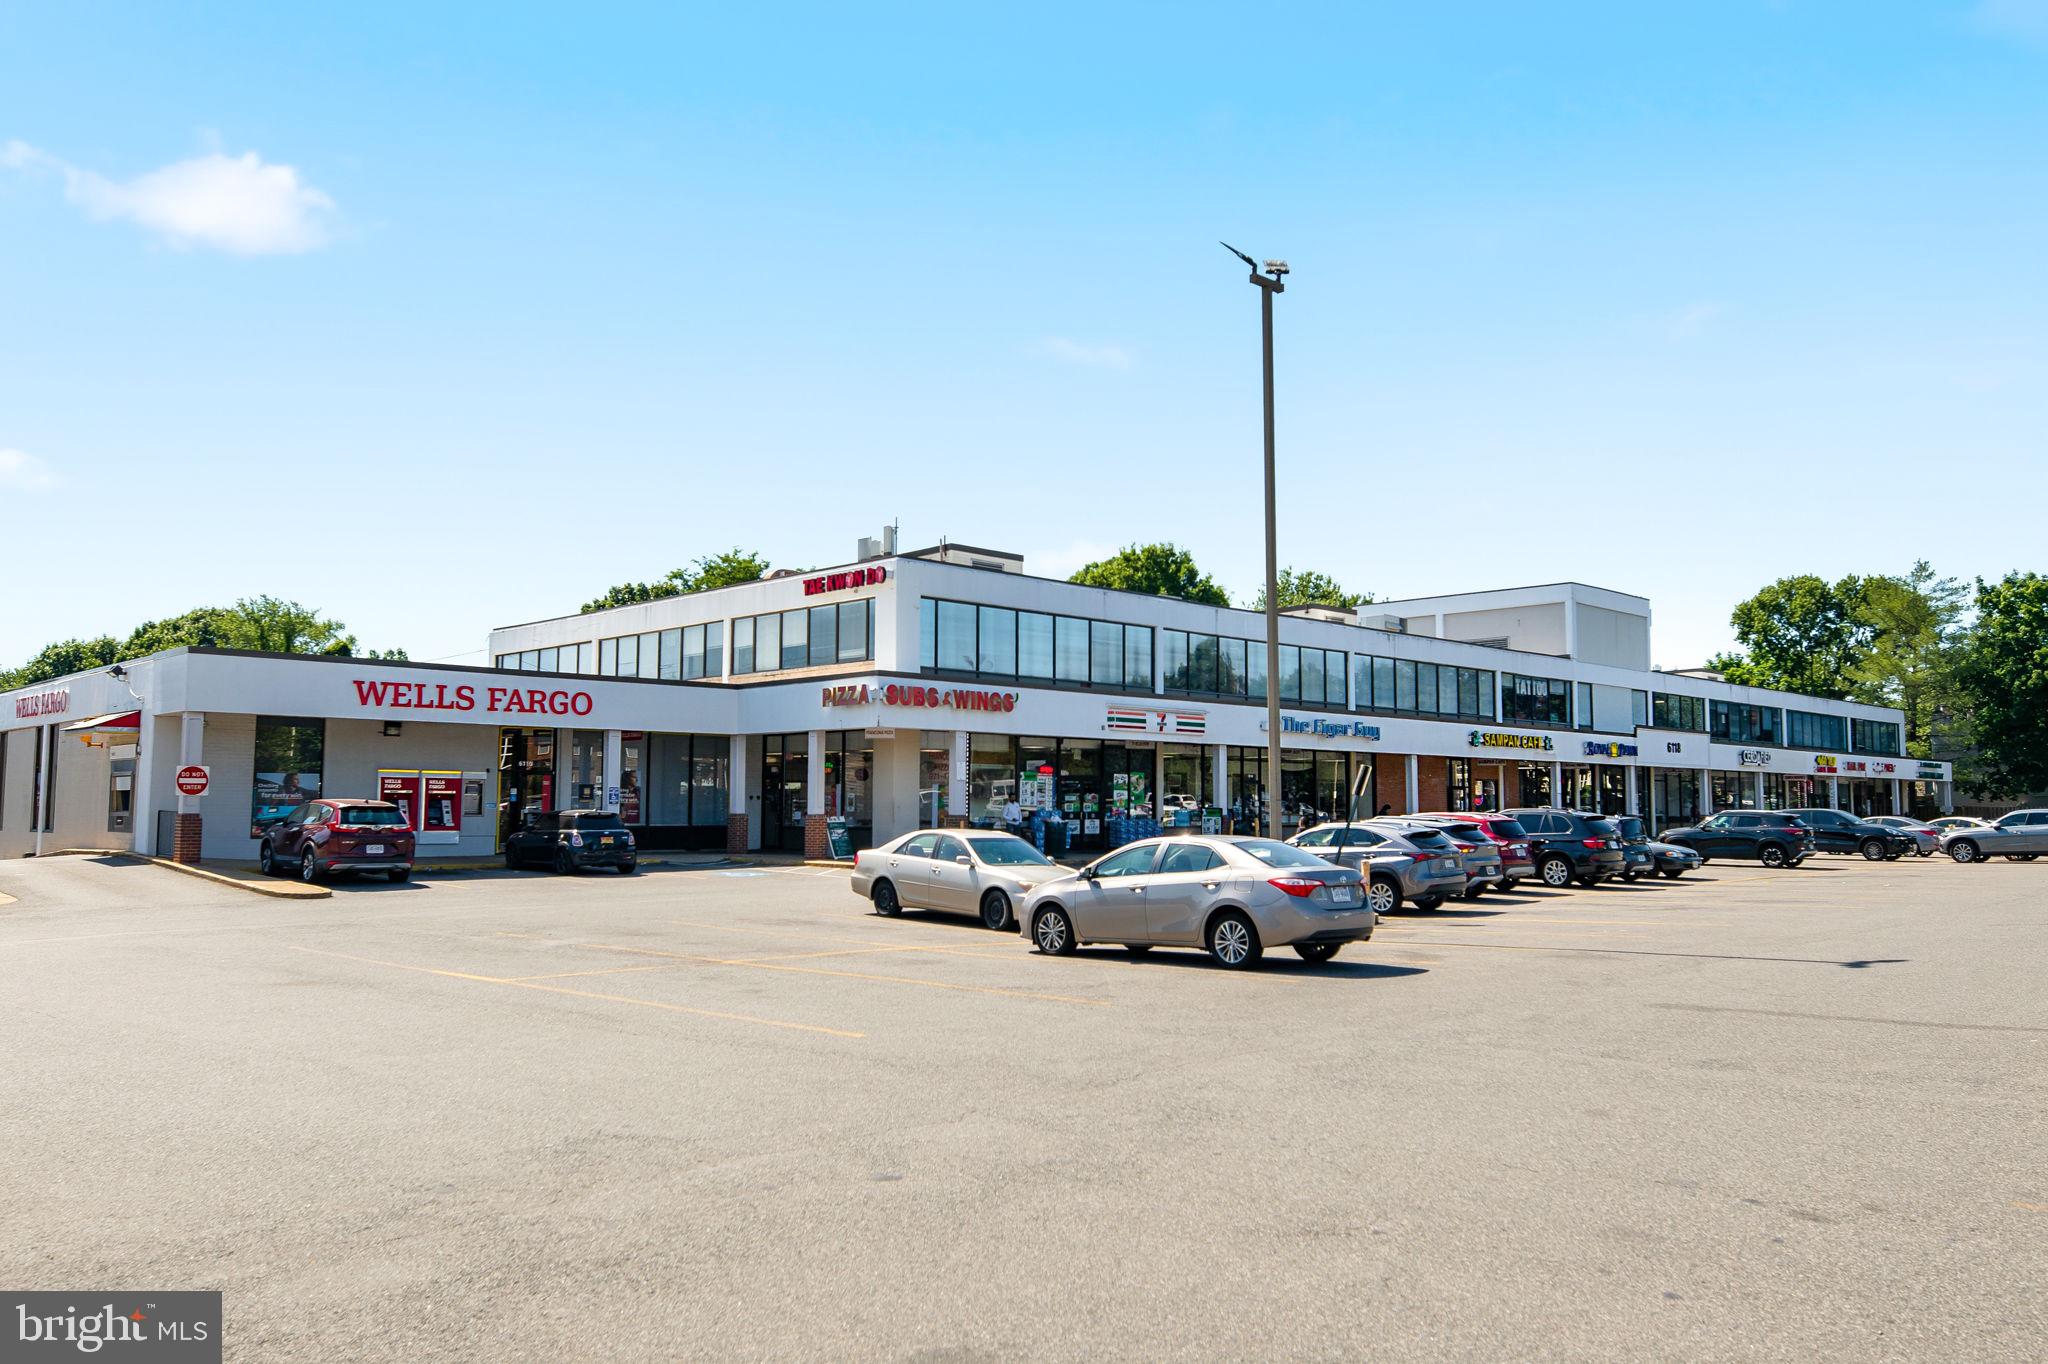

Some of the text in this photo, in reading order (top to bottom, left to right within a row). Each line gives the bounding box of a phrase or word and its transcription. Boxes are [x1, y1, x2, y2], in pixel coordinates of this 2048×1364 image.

[803, 565, 887, 596] TAE KWON DO
[16, 690, 67, 719] WELLS FARGO
[353, 680, 593, 716] WELLS FARGO
[822, 684, 870, 707] PIZZA
[886, 684, 939, 708] SUBS
[1282, 716, 1380, 741] The Cigar Guy
[1484, 733, 1520, 748] SAMPAN
